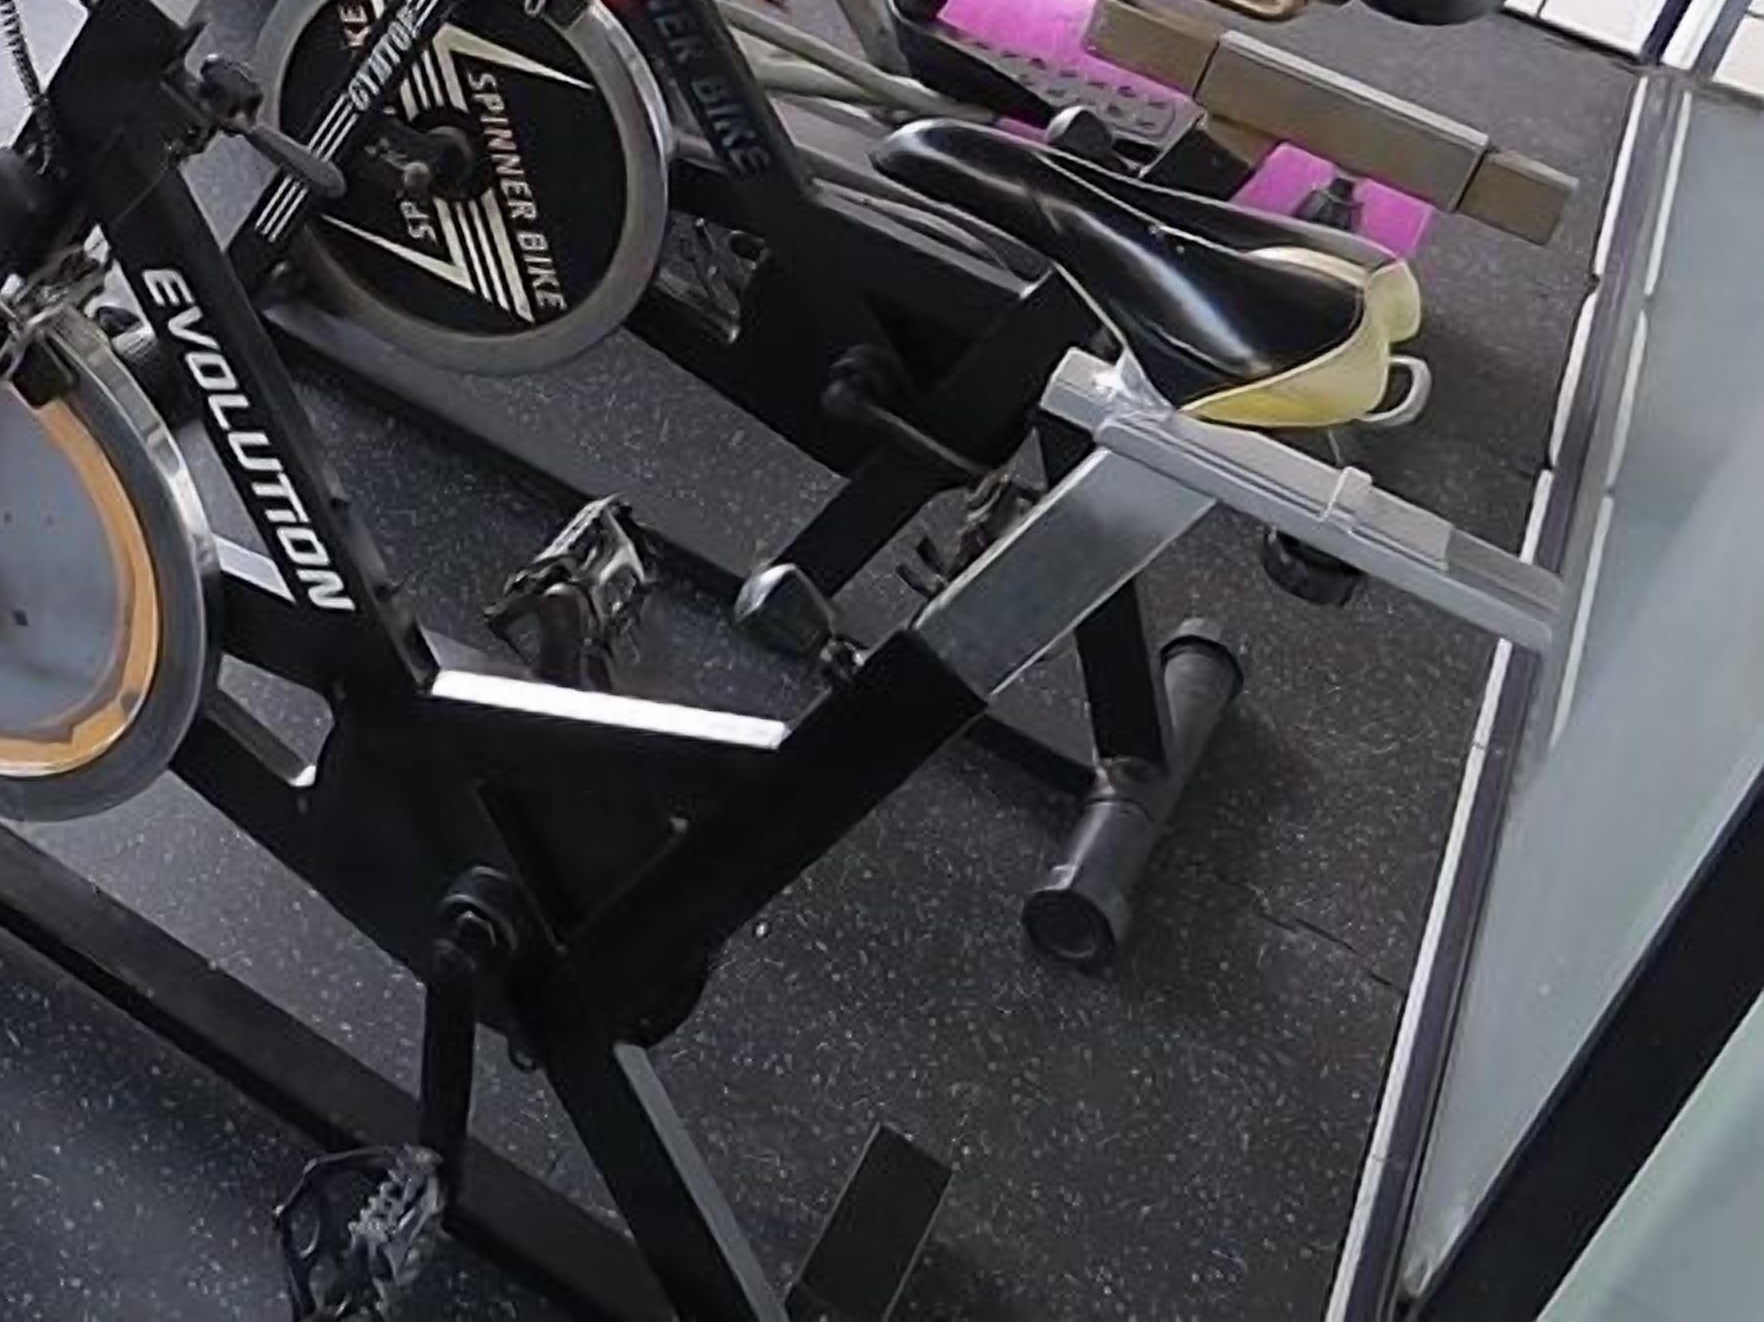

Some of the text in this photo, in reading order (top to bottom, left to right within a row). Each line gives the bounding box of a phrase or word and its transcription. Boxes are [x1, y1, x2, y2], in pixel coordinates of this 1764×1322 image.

[467, 71, 569, 312] SPINNER BIKE
[691, 80, 772, 174] BIKE
[141, 268, 356, 612] EVOLUTION
